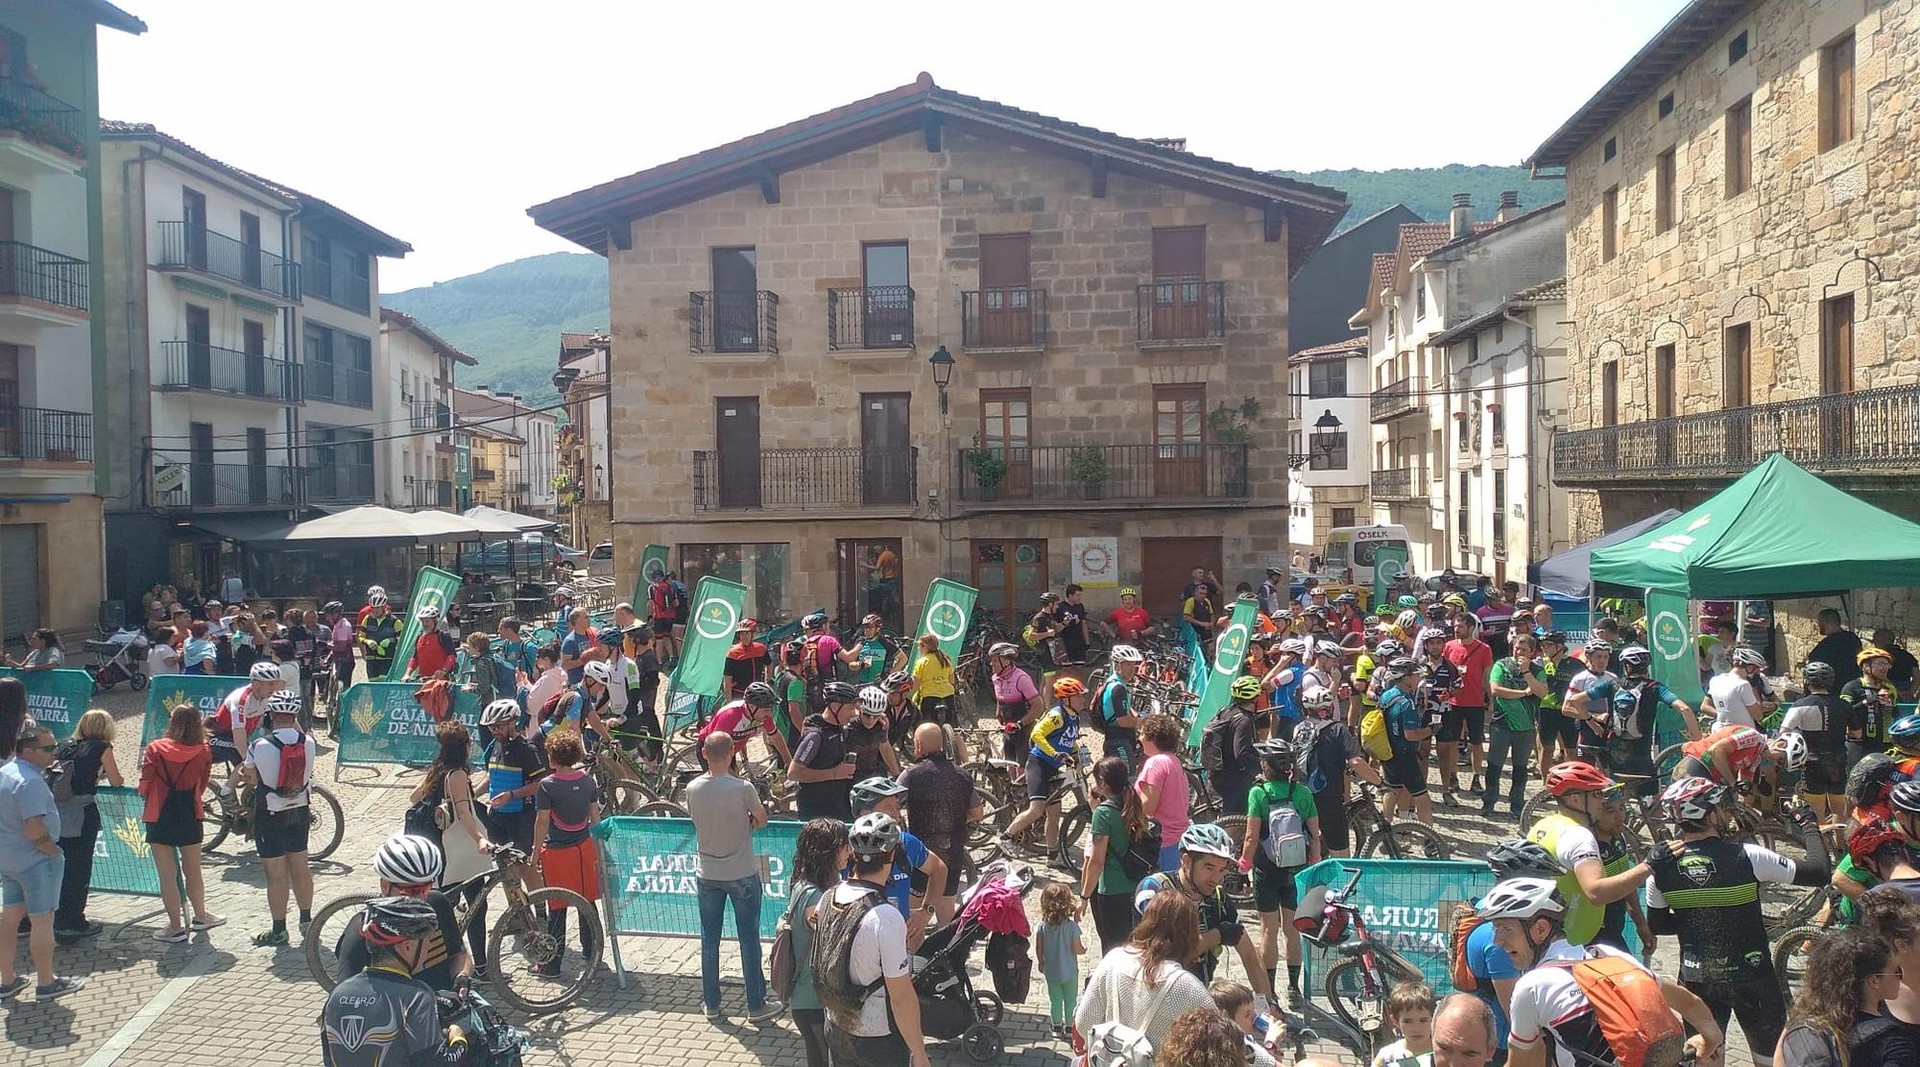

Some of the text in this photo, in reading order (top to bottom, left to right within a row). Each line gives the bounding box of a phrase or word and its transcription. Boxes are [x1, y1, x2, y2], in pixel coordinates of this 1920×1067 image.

[28, 694, 68, 709] RURAL
[31, 708, 70, 723] VARRA
[390, 708, 427, 722] CAJA
[387, 721, 408, 734] DE
[1684, 959, 1700, 969] BH
